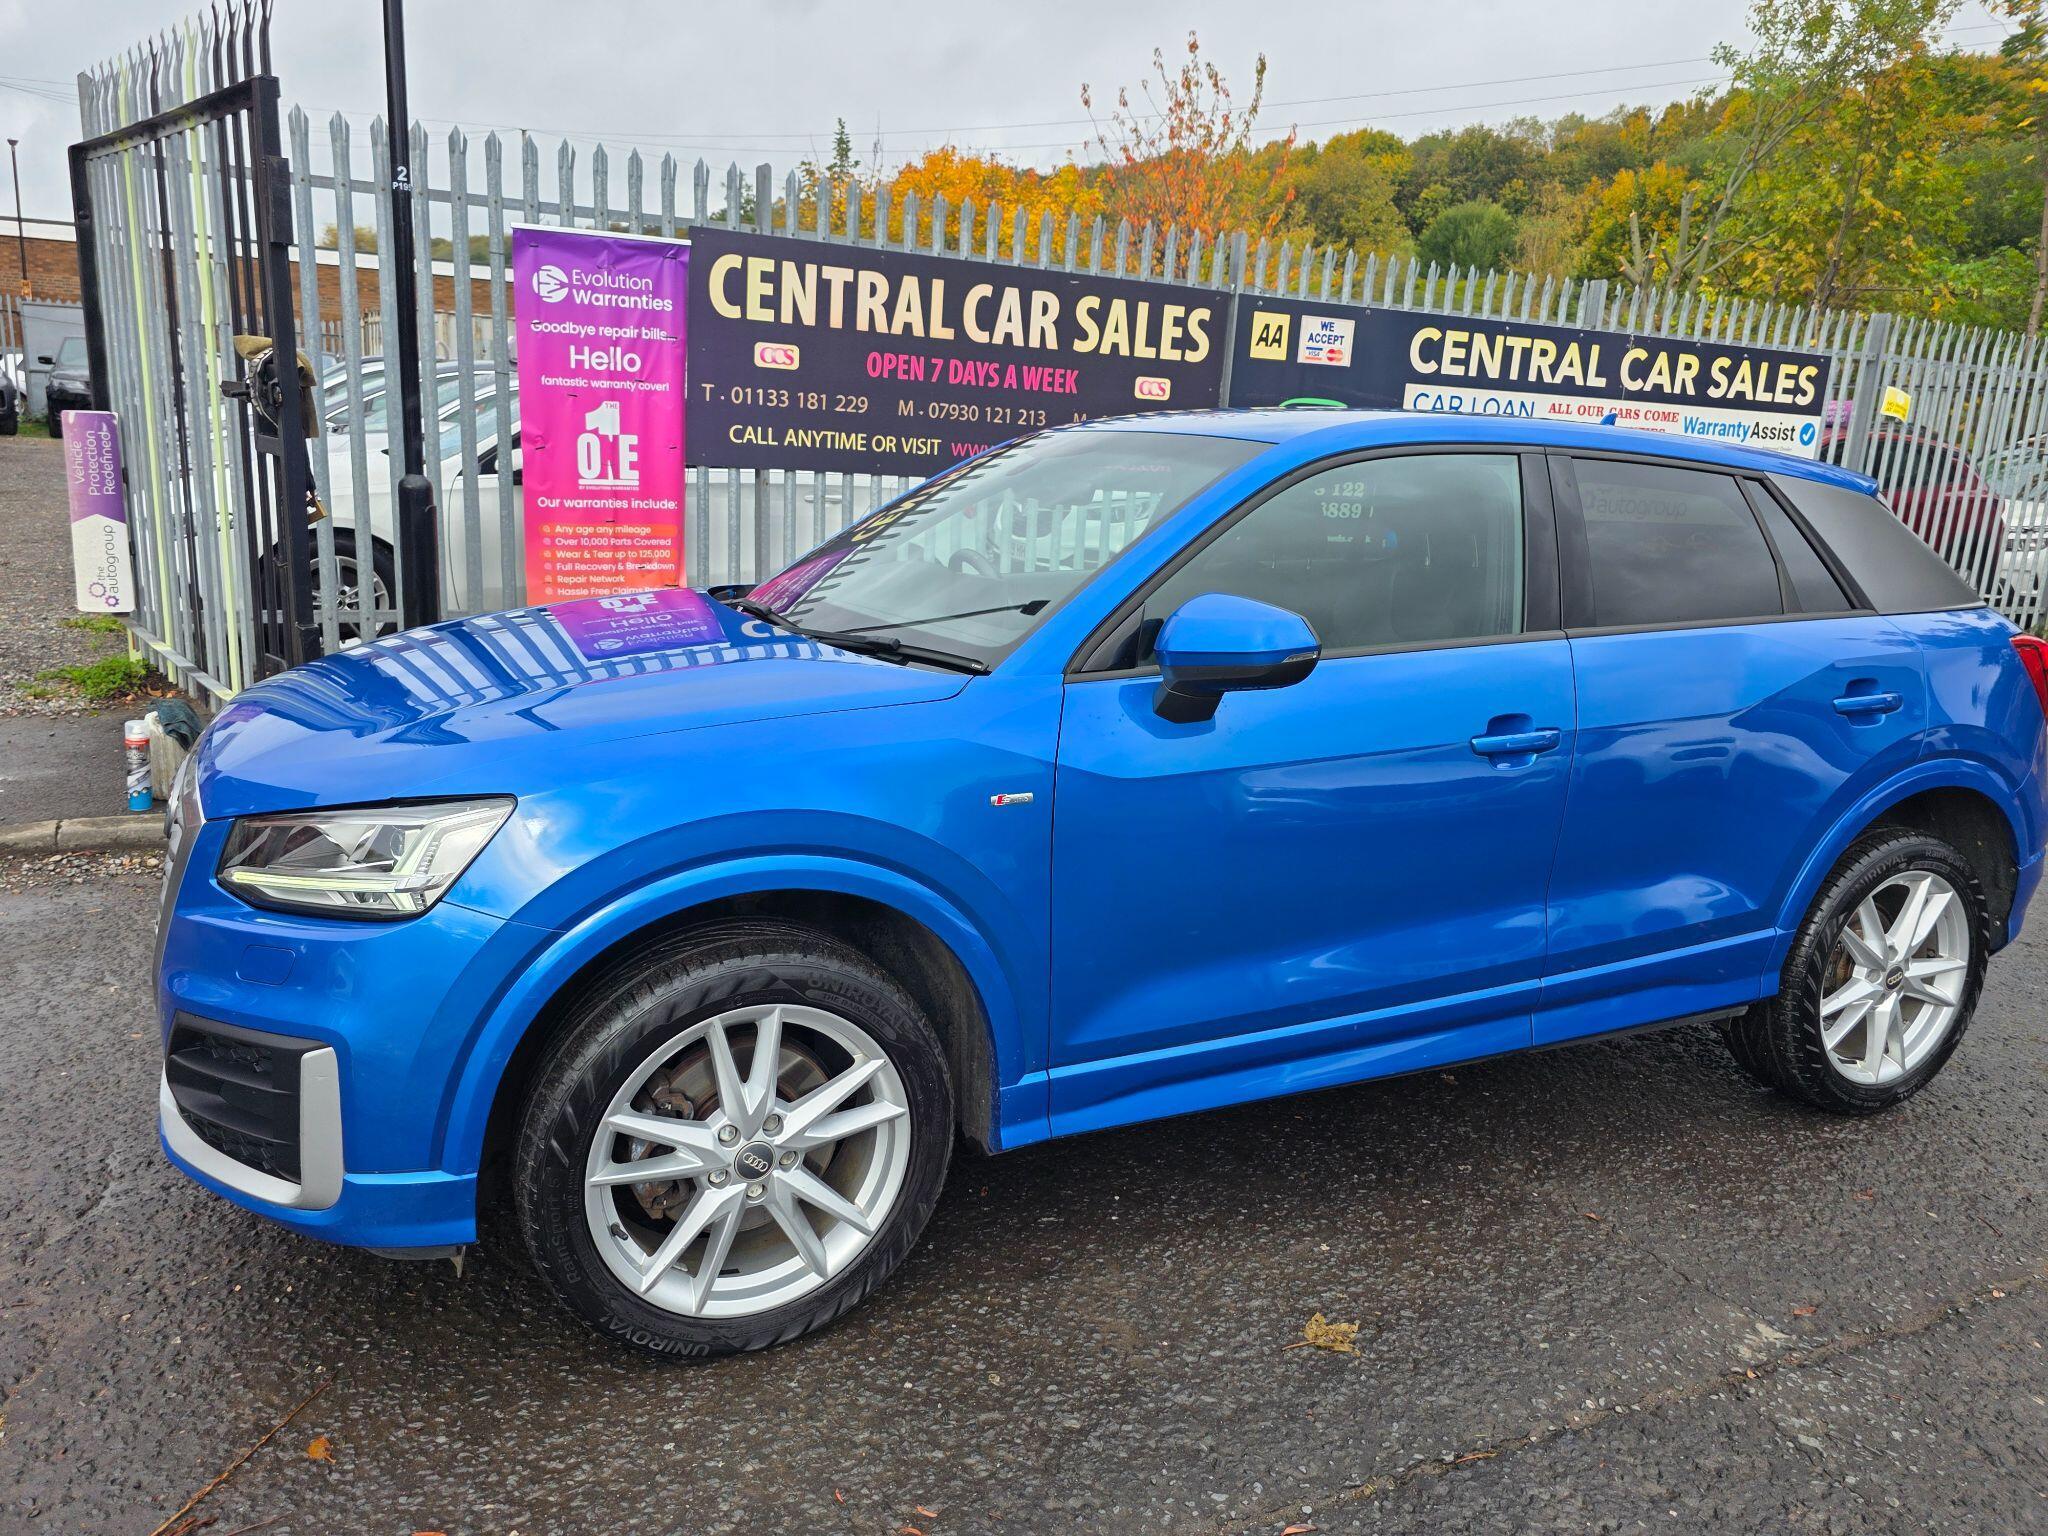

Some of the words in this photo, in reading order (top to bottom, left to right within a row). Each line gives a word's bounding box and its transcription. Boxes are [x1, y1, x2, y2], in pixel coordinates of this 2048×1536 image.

[397, 165, 408, 181] 2
[572, 269, 652, 291] Evolution
[572, 289, 673, 312] Warranties
[709, 253, 955, 340] CENTRAL
[963, 283, 1060, 350] CAR
[1073, 295, 1212, 363] SALES
[531, 319, 595, 338] Goodbye
[599, 326, 638, 340] repair
[1255, 323, 1283, 348] AA
[1320, 321, 1335, 332] WE
[1307, 332, 1345, 346] ACCEPT
[569, 345, 641, 372] Hello
[1409, 326, 1607, 388] CENTRAL
[1620, 348, 1700, 396] CAR
[1706, 356, 1819, 406] SALES
[541, 374, 589, 388] fantastic
[591, 378, 636, 392] warranty
[638, 380, 670, 392] cover!
[867, 352, 924, 382] OPEN
[930, 358, 944, 383] 7
[949, 359, 999, 388] DAYS
[1003, 364, 1017, 389] A
[1022, 366, 1079, 394] WEEK
[731, 387, 789, 408] 01133
[797, 392, 826, 410] 181
[834, 395, 868, 413] 229
[928, 403, 979, 421] 07930
[985, 406, 1011, 424] 121
[1018, 409, 1046, 426] 213
[1413, 392, 1463, 412] CAR
[1548, 403, 1572, 415] ALL
[1577, 404, 1604, 417] OUR
[1644, 409, 1680, 423] COME
[729, 425, 778, 446] CALL
[784, 429, 867, 451] ANYTIME
[872, 435, 896, 453] OR
[901, 437, 942, 456] VISIT
[72, 440, 86, 484] Vehicle
[85, 430, 101, 496] Protection
[100, 431, 116, 495] Redefined
[537, 497, 560, 508] Our
[564, 498, 628, 509] warranties
[631, 498, 678, 510] include:
[555, 525, 573, 535] Any
[576, 526, 594, 536] age
[596, 526, 614, 536] any
[615, 525, 651, 536] mileage
[555, 538, 578, 546] Over
[580, 537, 608, 547] 10,000
[611, 538, 632, 546] Parts
[633, 538, 671, 546] Covered
[104, 525, 120, 593] autogroup
[556, 550, 581, 558] Wear
[584, 550, 590, 558] &
[593, 550, 613, 558] Tear
[615, 552, 626, 560] up
[628, 550, 637, 558] to
[639, 550, 671, 559] 125,000
[97, 566, 105, 581] the
[556, 563, 572, 571] Full
[575, 563, 616, 573] Recovery
[626, 561, 675, 571] Breakdown
[557, 575, 587, 584] Repair
[590, 575, 625, 583] Network
[557, 587, 588, 595] Hassle
[590, 587, 610, 595] Free
[612, 586, 644, 594] Claims
